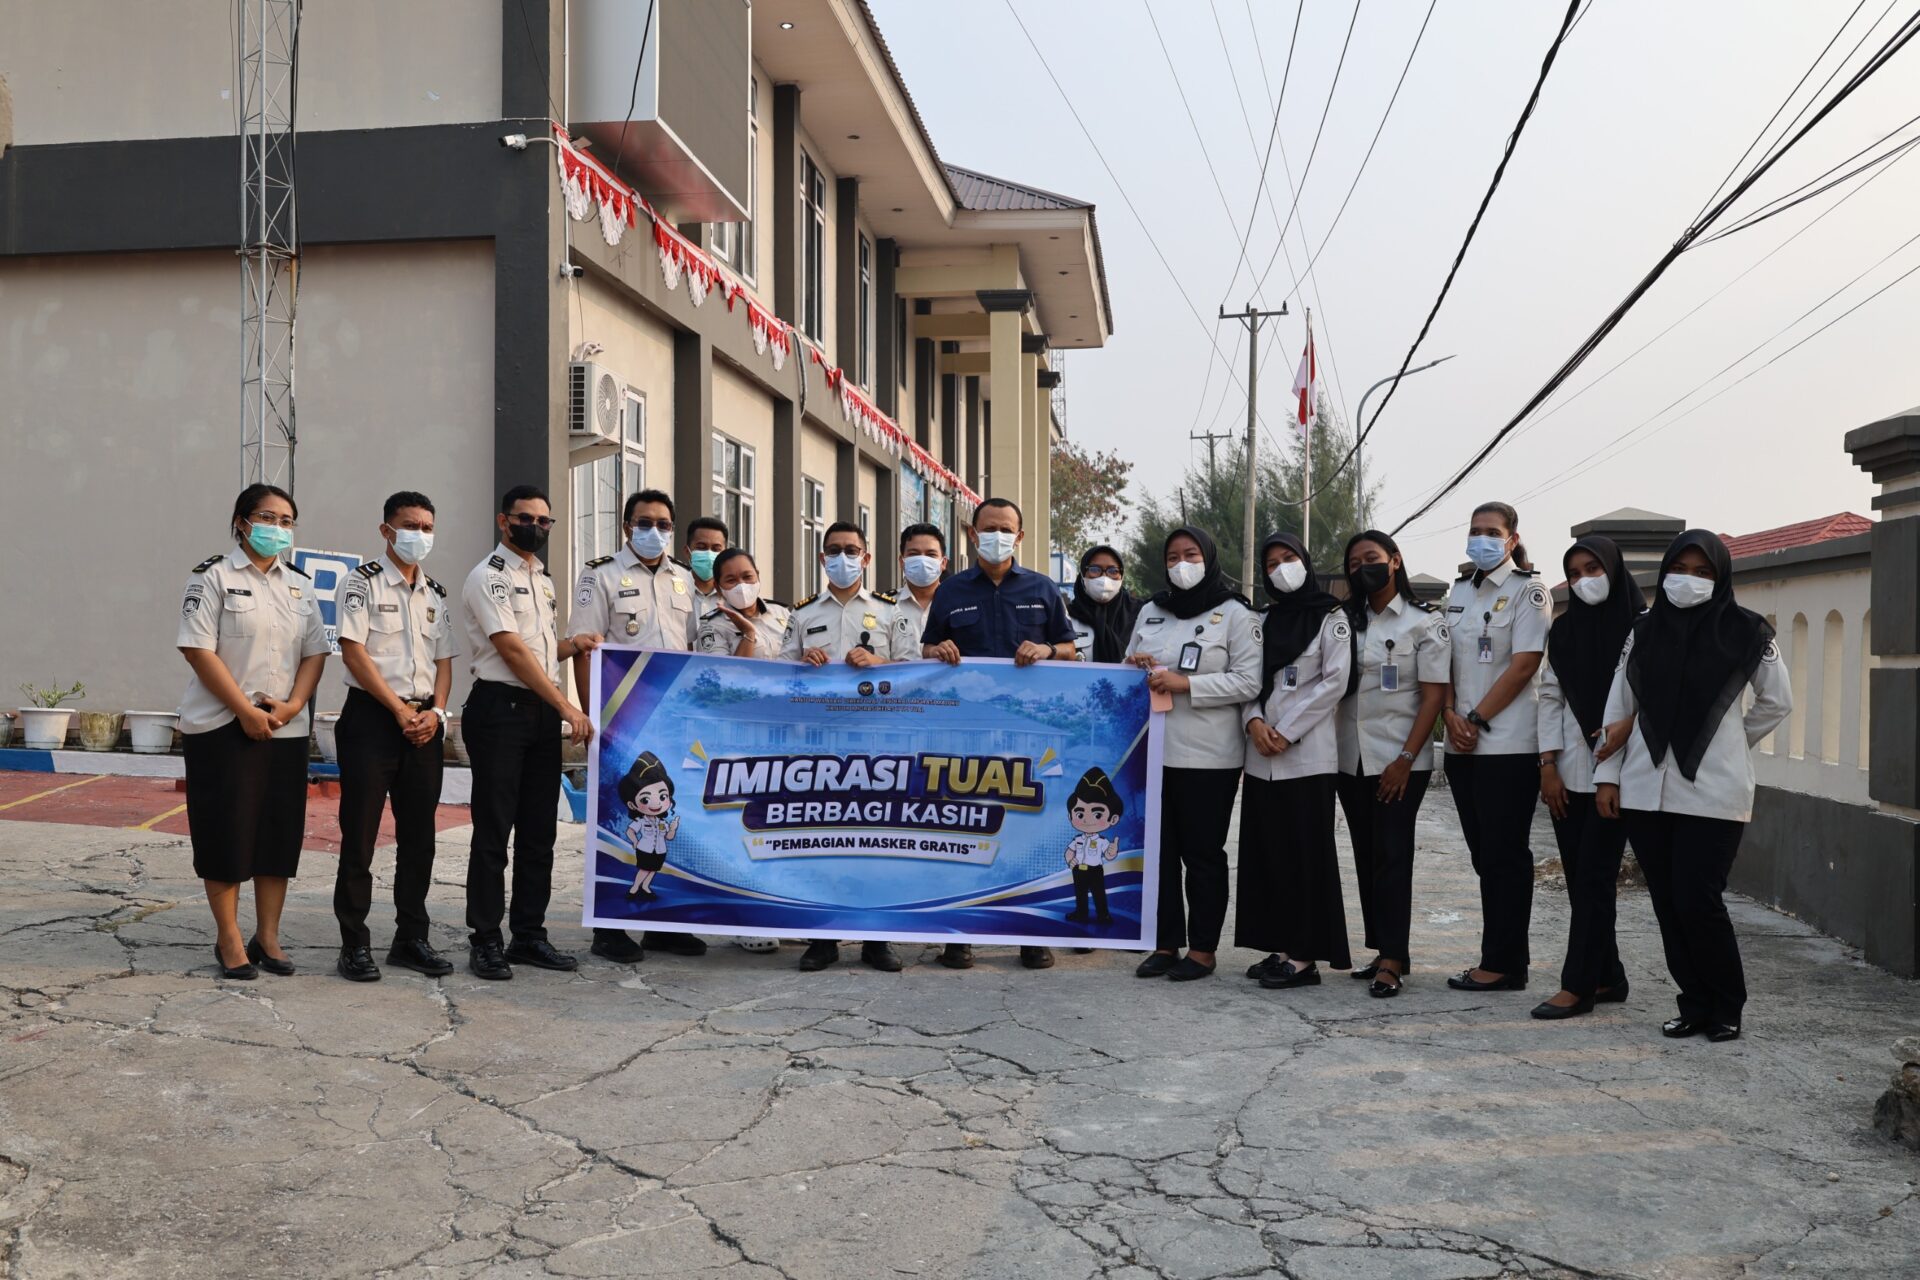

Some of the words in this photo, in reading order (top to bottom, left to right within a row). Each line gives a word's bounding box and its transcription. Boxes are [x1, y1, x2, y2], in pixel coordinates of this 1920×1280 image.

[713, 759, 910, 796] IMIGRASI
[922, 756, 1036, 797] TUAL
[765, 801, 892, 824] BERBAGI
[900, 802, 989, 827] KASIH
[858, 837, 917, 850] MASKER
